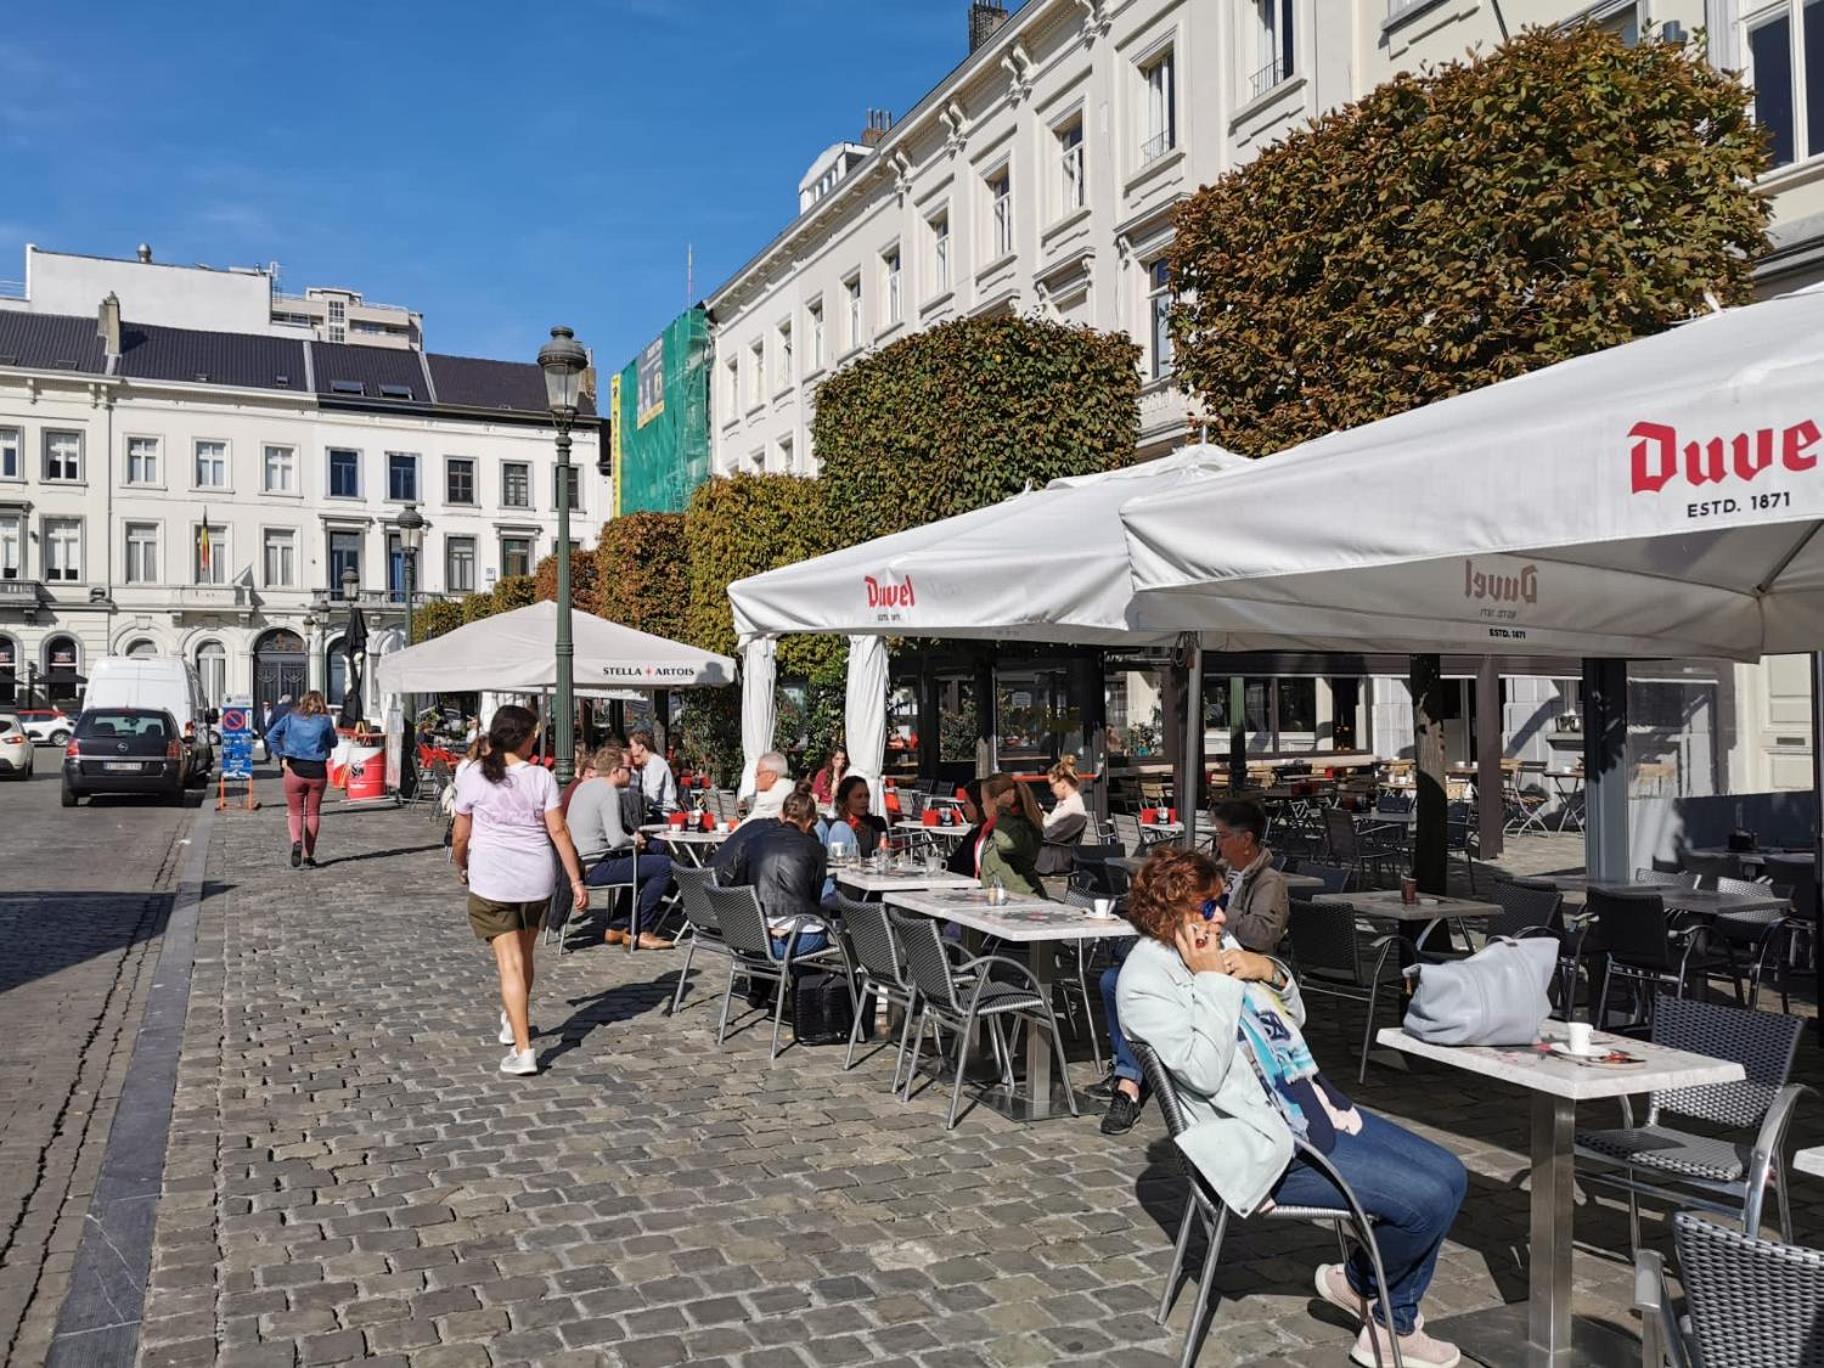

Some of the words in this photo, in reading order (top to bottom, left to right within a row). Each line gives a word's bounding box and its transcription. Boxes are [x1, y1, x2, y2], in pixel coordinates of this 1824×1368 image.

[1627, 419, 1823, 495] Duve
[1687, 498, 1741, 518] ESTD.
[1750, 491, 1791, 511] 1871
[864, 574, 915, 608] Duvel
[603, 667, 642, 676] STELLA
[655, 667, 695, 676] ARTOIS
